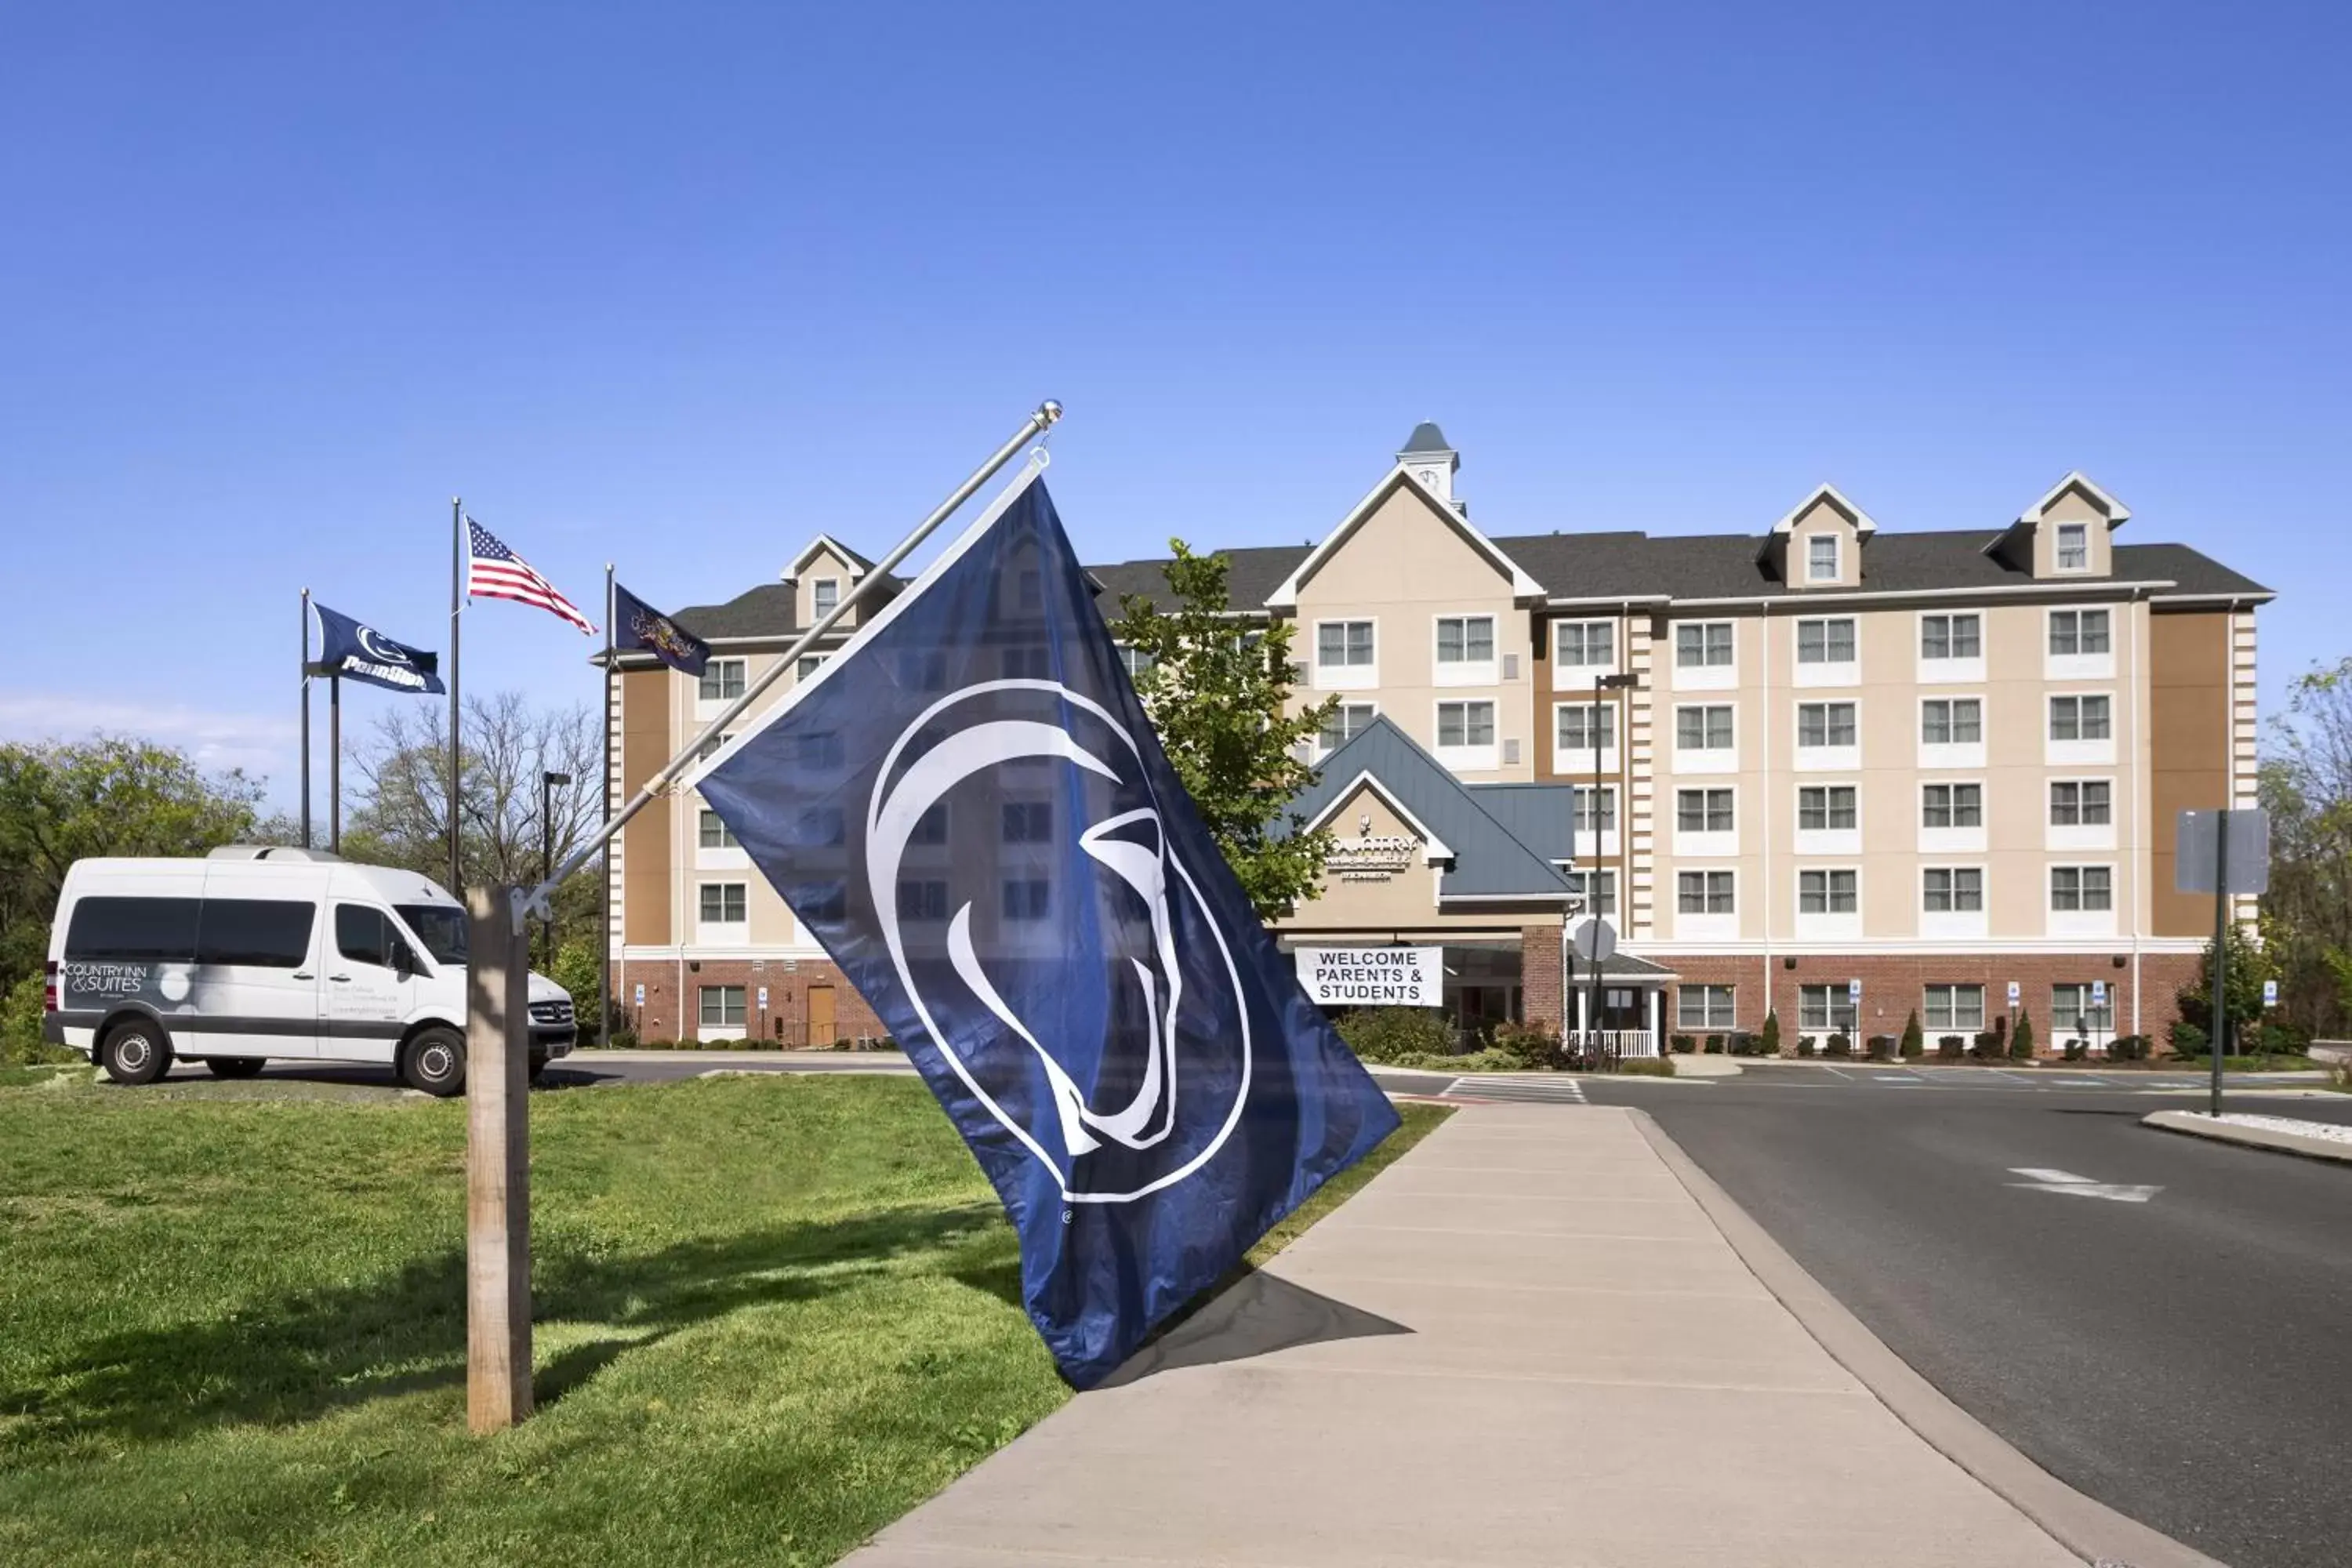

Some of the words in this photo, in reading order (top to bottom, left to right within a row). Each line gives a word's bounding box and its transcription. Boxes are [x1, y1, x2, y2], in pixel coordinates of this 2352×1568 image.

[1319, 953, 1417, 965] WELCOME
[66, 964, 123, 977] COUNTRY
[125, 965, 147, 978] INN
[1316, 968, 1403, 982] PARENTS
[1410, 968, 1423, 982] &
[1319, 985, 1420, 999] STUDENTS
